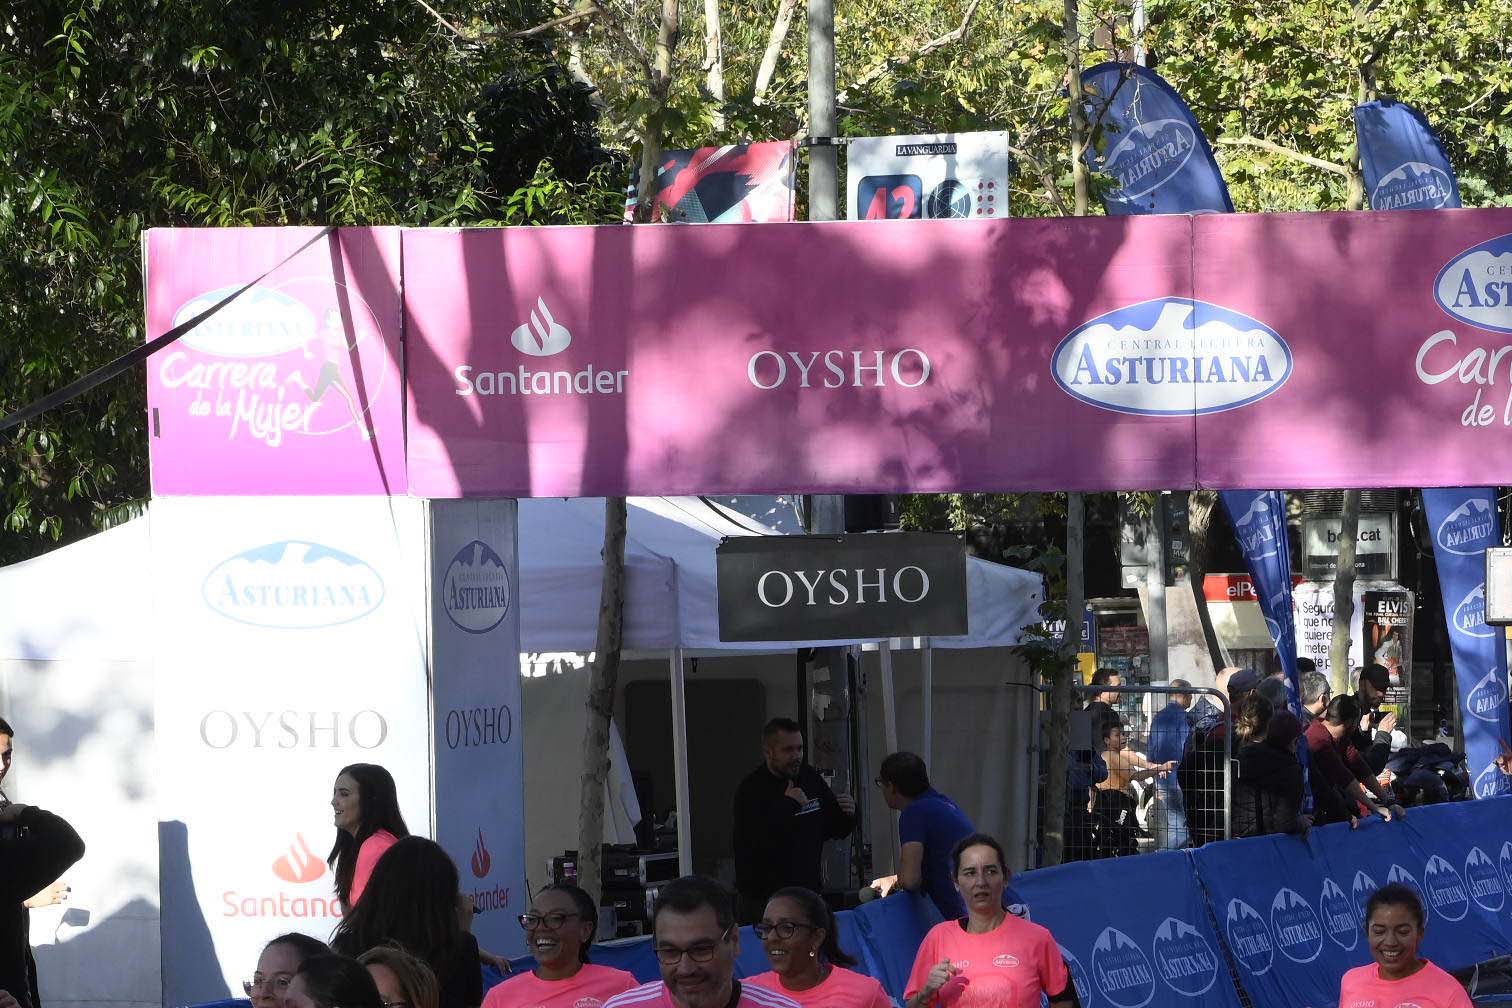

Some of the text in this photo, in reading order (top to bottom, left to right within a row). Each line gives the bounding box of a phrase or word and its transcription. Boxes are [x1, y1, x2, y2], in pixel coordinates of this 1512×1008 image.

[1107, 337, 1185, 350] CENTRAL
[160, 351, 278, 392] Carrera
[456, 363, 629, 396] Santander
[747, 348, 931, 390] OYSHO
[1070, 341, 1272, 386] ASTURIANA
[189, 386, 323, 447] de la Mujer
[1461, 389, 1496, 427] de
[1328, 528, 1380, 543] bc.cat
[217, 574, 372, 608] ASTURIANA
[449, 575, 506, 611] ASTURIANA
[757, 566, 930, 608] OYSHO
[1304, 630, 1333, 643] quiere
[200, 709, 388, 749] OYSHO
[445, 704, 511, 751] OYSHO
[1280, 920, 1321, 948] ASTURIANA
[1098, 960, 1153, 992] ASTURIANA
